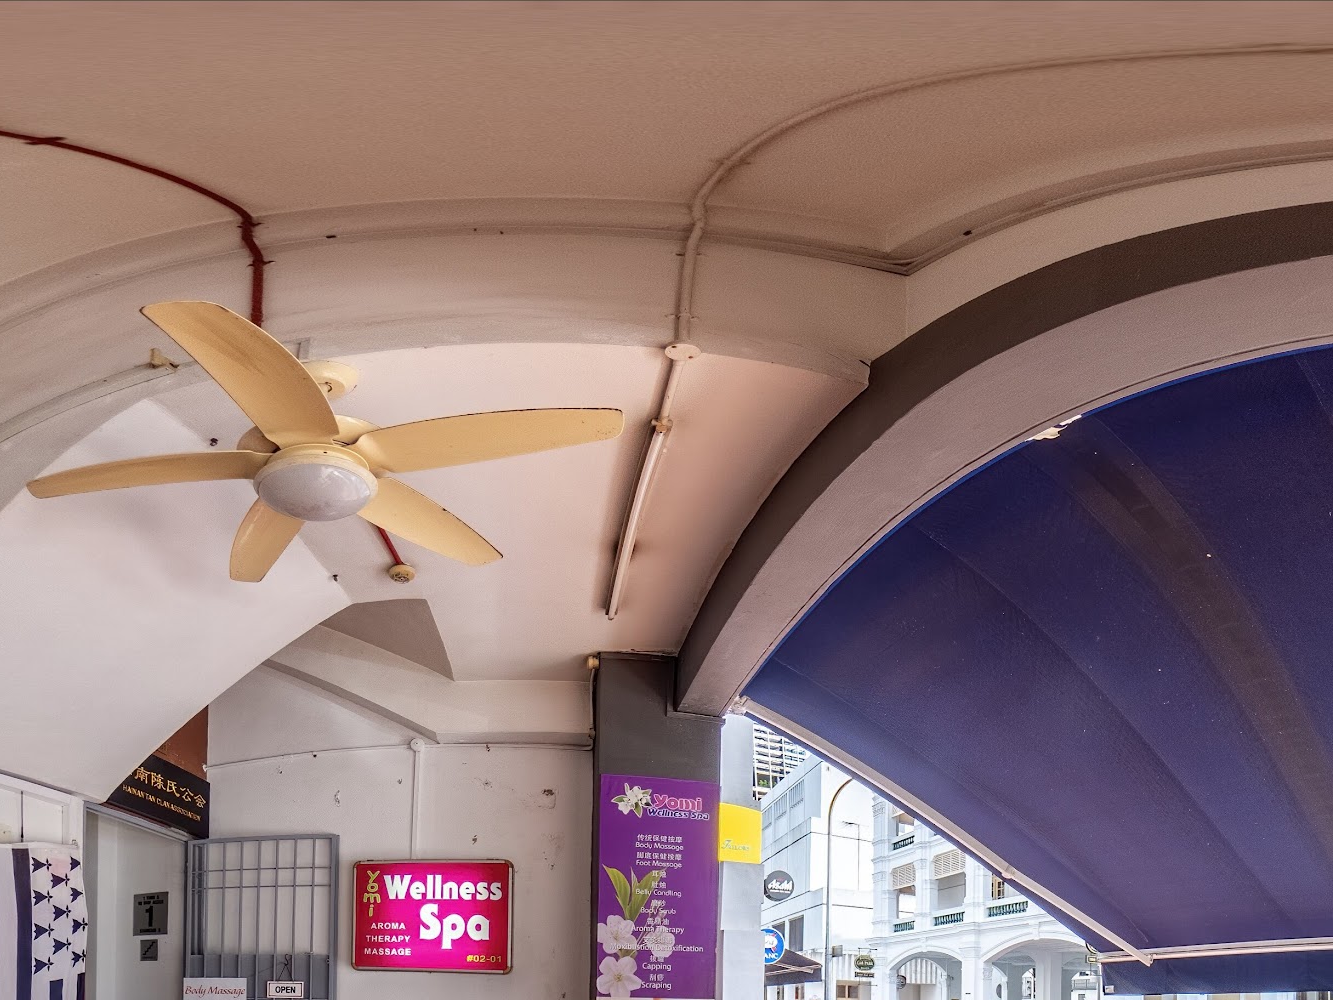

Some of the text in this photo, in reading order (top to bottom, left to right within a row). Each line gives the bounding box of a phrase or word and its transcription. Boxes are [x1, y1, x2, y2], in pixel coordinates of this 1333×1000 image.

[383, 874, 503, 901] Wellness
[145, 905, 154, 928] 1
[370, 922, 406, 930] AROMA
[419, 903, 490, 950] Spa
[365, 935, 411, 943] THERAPY
[364, 948, 412, 956] MASSAGE
[642, 962, 672, 971] Capping
[275, 986, 296, 994] OPEN
[641, 982, 672, 991] Scraping
[185, 985, 245, 999] Body Massage
